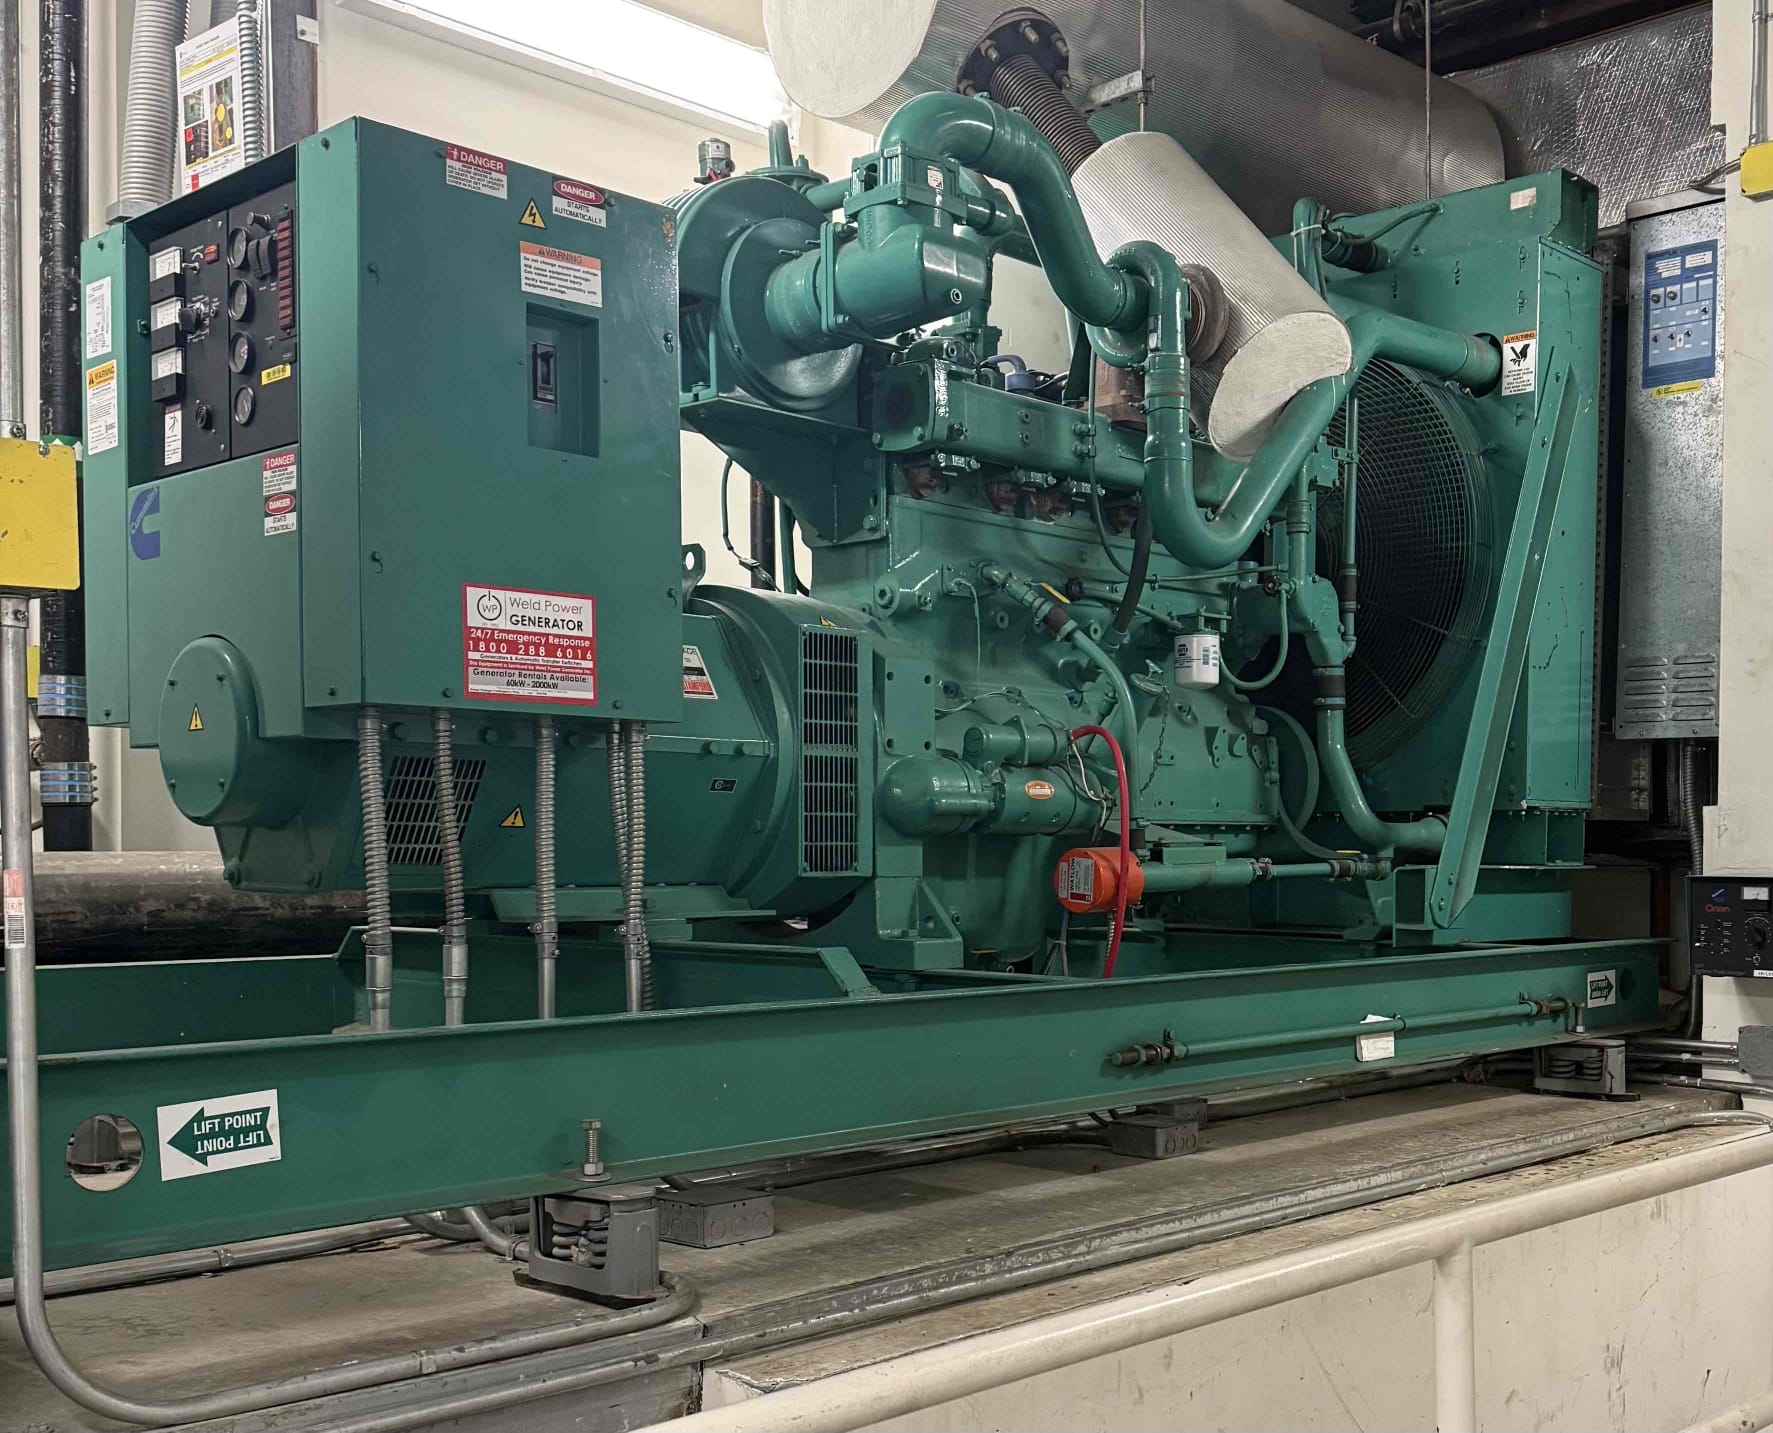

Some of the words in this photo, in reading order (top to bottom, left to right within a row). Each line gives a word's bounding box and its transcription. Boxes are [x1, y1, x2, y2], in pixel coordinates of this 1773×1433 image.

[460, 151, 504, 172] DANGER
[560, 183, 596, 200] DANGER
[554, 206, 603, 225] AUTOMATICALLY
[566, 201, 590, 213] STARTS
[545, 247, 583, 265] WARNING
[1510, 333, 1534, 341] WARNING
[270, 454, 295, 468] DANGER
[130, 487, 158, 535] Cummins
[269, 498, 291, 510] DANGER
[482, 603, 498, 614] WP
[509, 596, 541, 611] Weld
[544, 600, 584, 615] Power
[509, 614, 584, 632] GENERATOR
[470, 628, 492, 640] 24/7
[494, 630, 547, 646] Emergency
[548, 635, 591, 648] Response
[518, 645, 546, 657] 288
[556, 650, 593, 660] 6016
[473, 668, 516, 677] Generator
[518, 672, 547, 681] Rentals
[506, 679, 527, 688] 60kW
[531, 681, 559, 689] 2000kW
[193, 1118, 221, 1135] LIFT
[224, 1112, 263, 1130] POINT
[195, 1136, 234, 1154] POINT
[237, 1130, 265, 1147] LIFT
